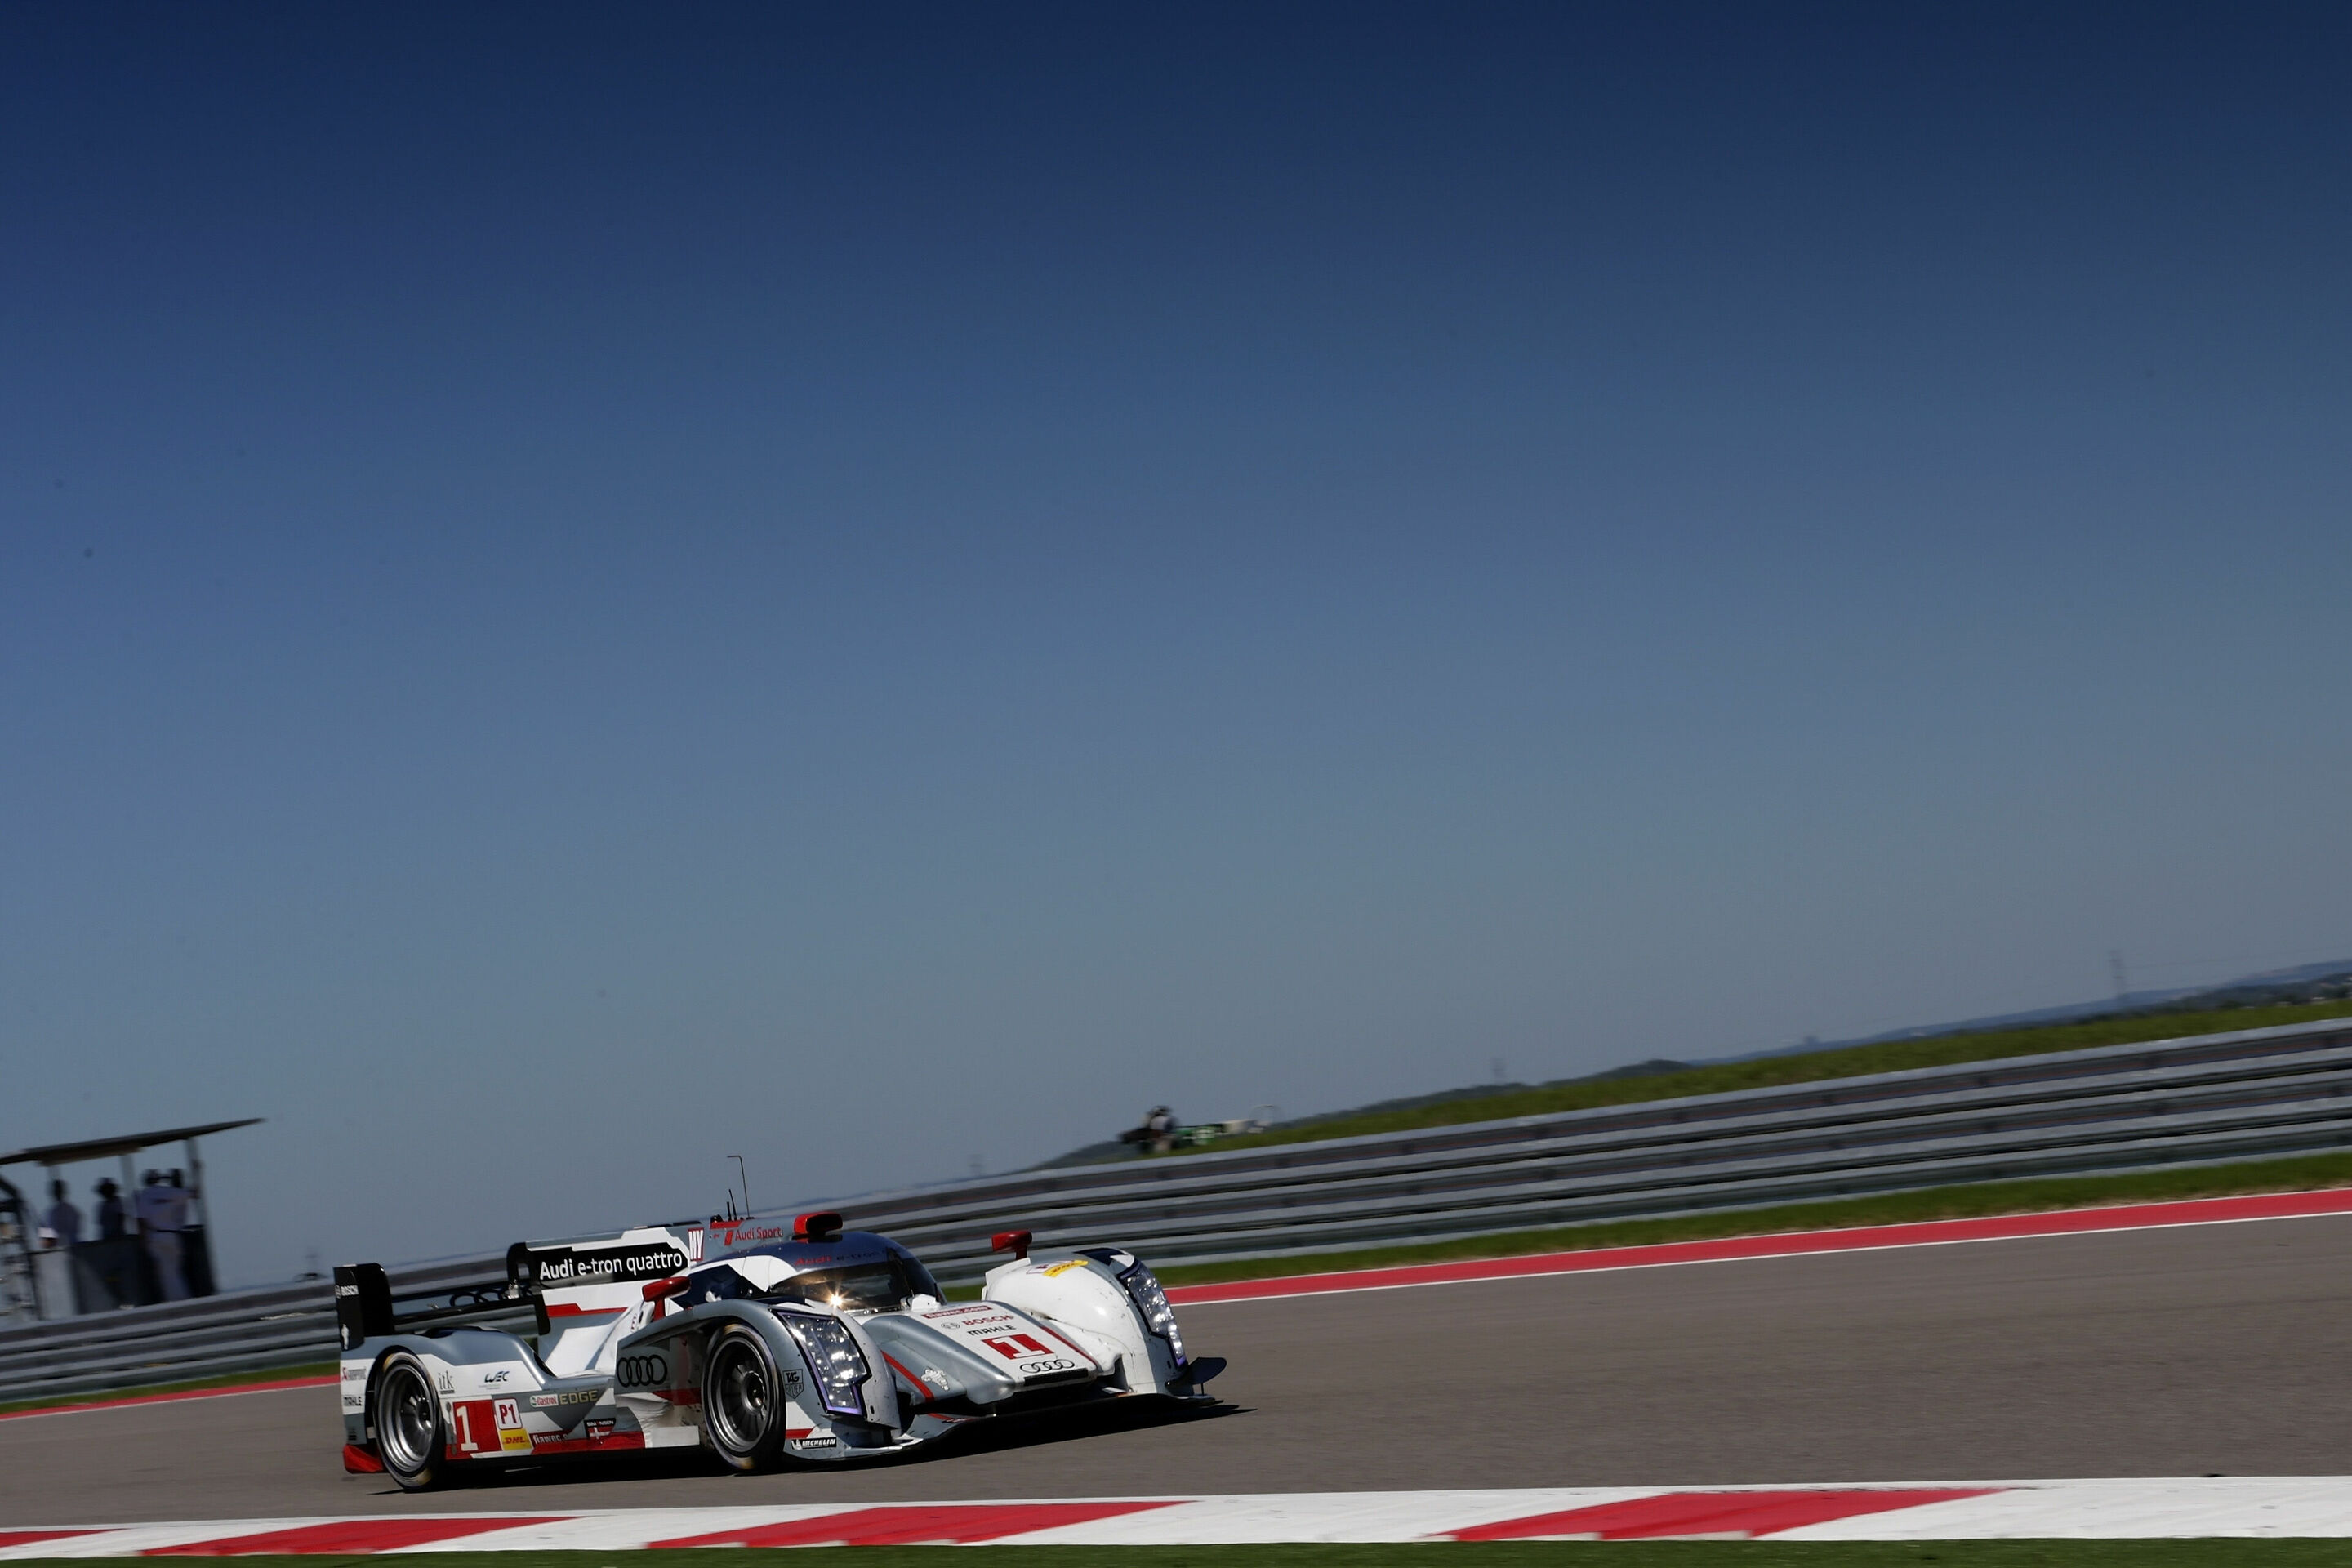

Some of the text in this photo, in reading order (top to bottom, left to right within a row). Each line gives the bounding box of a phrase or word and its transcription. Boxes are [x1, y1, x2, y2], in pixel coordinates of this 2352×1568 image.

[736, 1227, 781, 1241] Audi Sport
[688, 1228, 703, 1260] HY
[540, 1250, 683, 1281] Audi e-tron quattro
[795, 1255, 832, 1266] Audi
[962, 1315, 1014, 1326] BOSCH
[967, 1325, 1016, 1336] MAHLE
[991, 1336, 1045, 1358] 1
[484, 1371, 510, 1383] WEC
[786, 1372, 800, 1383] TAG
[537, 1390, 598, 1405] Castrol EDGE
[499, 1404, 517, 1424] P1
[456, 1405, 479, 1451] 1
[802, 1438, 836, 1446] MICHELIN
